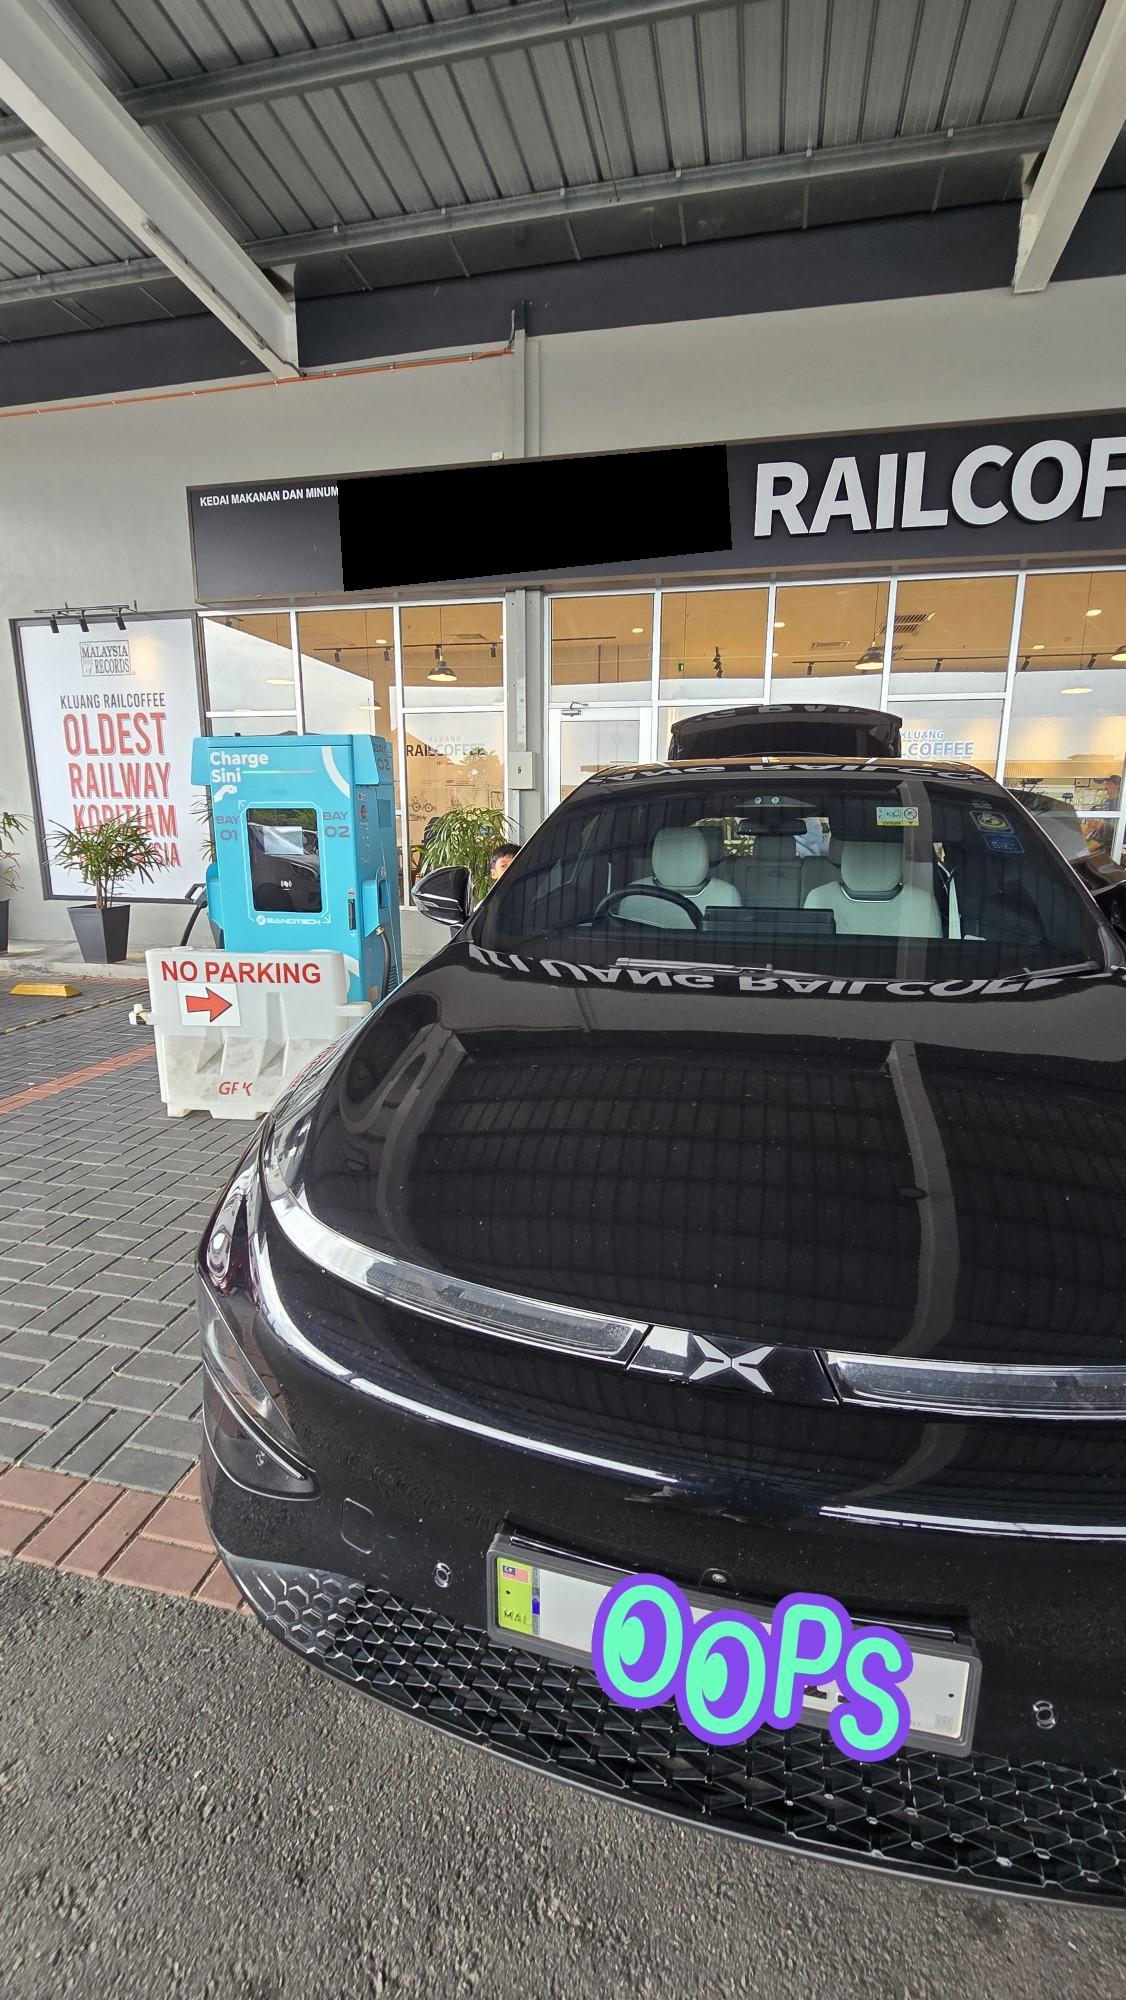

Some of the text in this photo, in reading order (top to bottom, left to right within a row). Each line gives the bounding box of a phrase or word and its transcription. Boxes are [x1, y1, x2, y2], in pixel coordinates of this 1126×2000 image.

[200, 494, 229, 507] KEDAI
[231, 491, 280, 504] MAKANAN
[282, 489, 304, 500] DAN
[81, 645, 129, 659] MALAYSIA
[94, 658, 130, 674] RECORDS
[60, 692, 166, 709] KLUANG RAILCOFFEE
[63, 711, 167, 757] OLDEST
[210, 751, 269, 767] Charge
[68, 761, 171, 799] RAILWAY
[211, 768, 241, 783] Sini
[216, 815, 240, 825] BAY
[323, 811, 348, 821] BAY
[220, 829, 239, 841] 01
[324, 825, 350, 838] 02
[161, 961, 321, 984] NO PARKING
